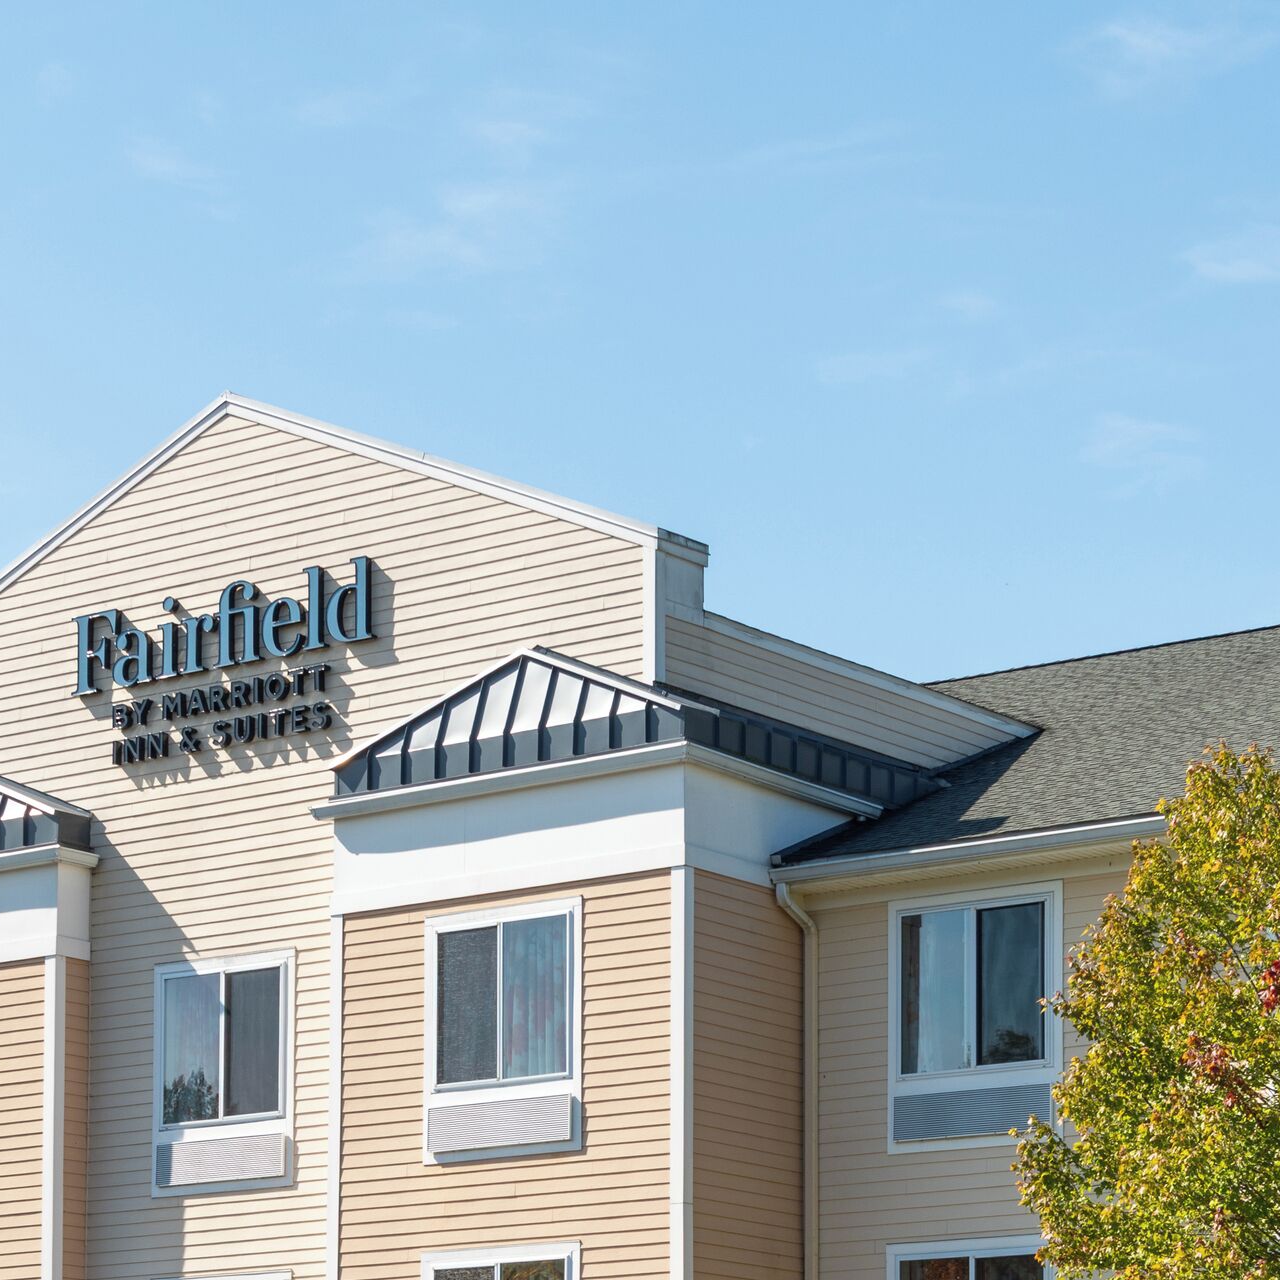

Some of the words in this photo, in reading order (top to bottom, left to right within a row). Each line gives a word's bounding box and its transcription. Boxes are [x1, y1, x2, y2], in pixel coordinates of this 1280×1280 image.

[71, 556, 376, 696] Fairfield
[112, 698, 152, 730] BY
[162, 664, 331, 722] MARRIOTT
[112, 731, 169, 765] INN
[179, 725, 201, 753] &
[212, 701, 332, 748] SUITES
